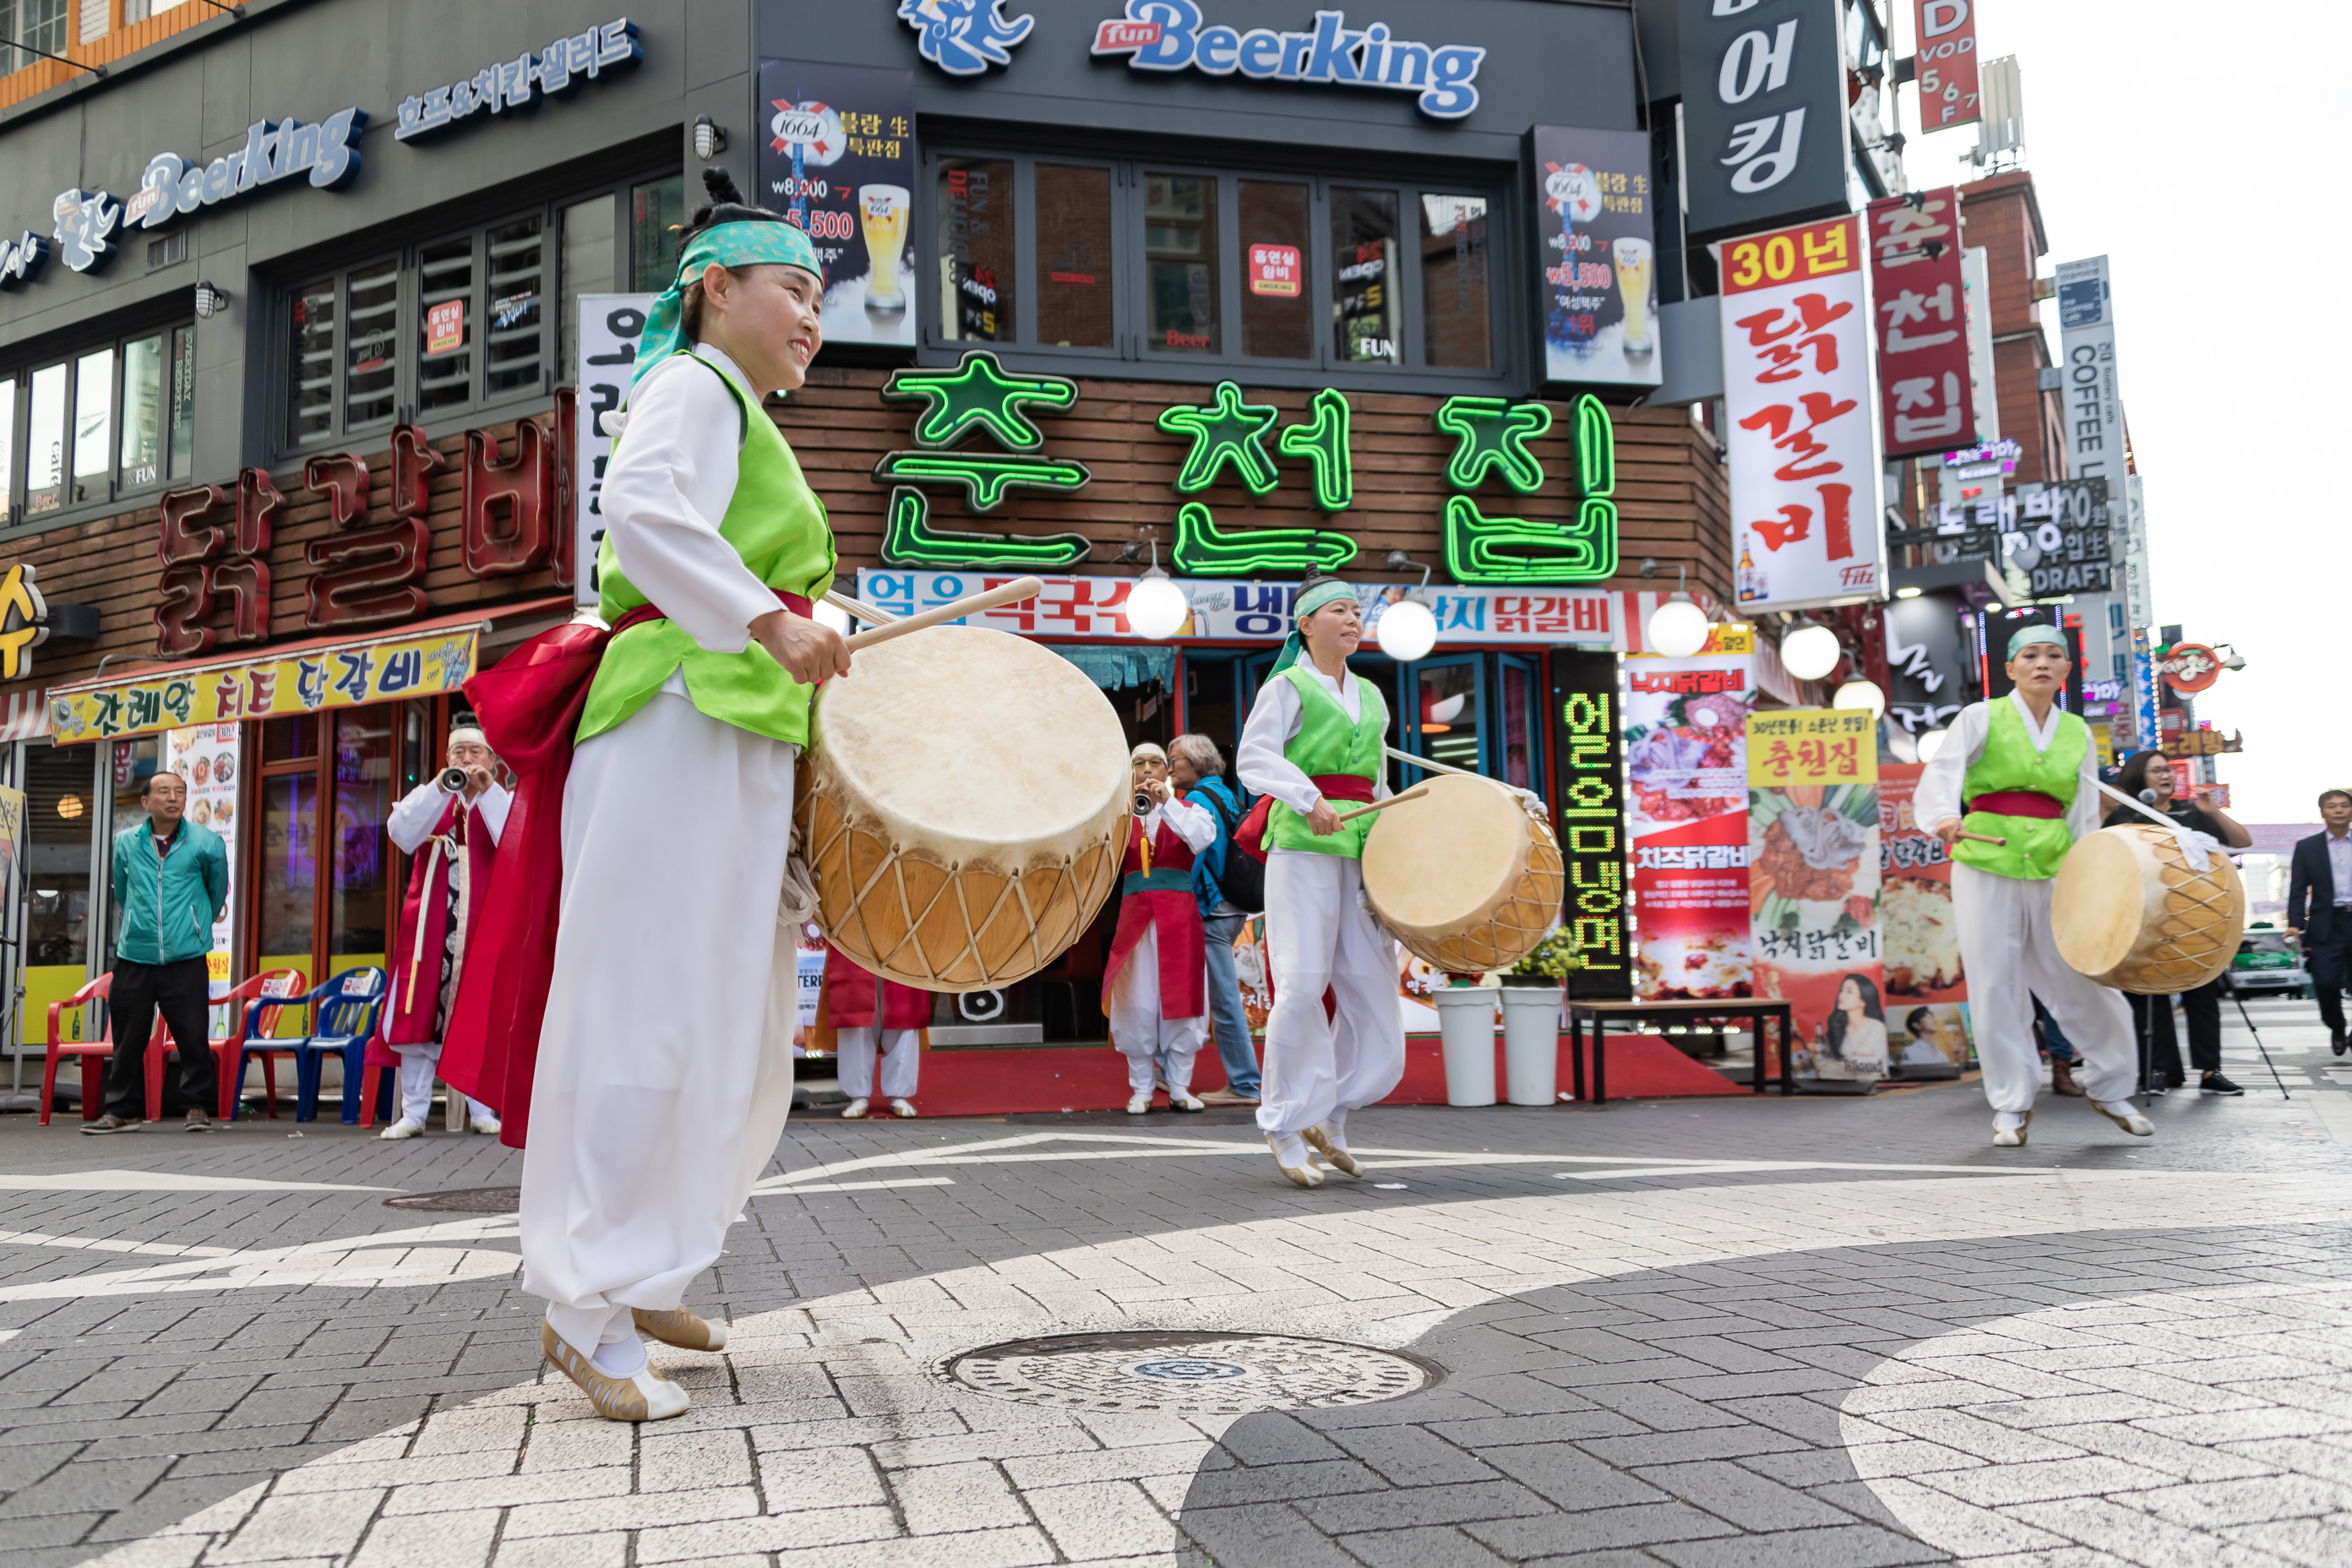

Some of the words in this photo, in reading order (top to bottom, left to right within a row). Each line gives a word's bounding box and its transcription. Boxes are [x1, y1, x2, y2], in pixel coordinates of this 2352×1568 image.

[1105, 23, 1153, 43] fun
[1127, 0, 1487, 118] Beerking
[1919, 35, 1976, 63] VOD
[779, 117, 819, 139] 1664
[890, 116, 910, 139] 生
[1941, 105, 1955, 123] F
[140, 107, 358, 228] Beerking
[1732, 223, 1850, 287] 30년
[1568, 313, 1594, 335] 1위
[1874, 199, 1963, 444] 춘천집
[1166, 329, 1210, 348] Beer
[1360, 338, 1396, 357] FUN
[2072, 344, 2104, 455] COFFEE
[1734, 292, 1858, 563] 닭갈비
[135, 467, 156, 485] FUN
[873, 350, 1619, 583] 춘천집
[1961, 486, 1983, 499] 3F
[154, 388, 577, 658] 닭갈비
[1937, 485, 2063, 553] 노래방
[1838, 561, 1875, 587] Fitz
[2033, 563, 2111, 592] DRAFT
[1233, 585, 1297, 635] 냉
[1493, 595, 1611, 634] 닭갈비
[296, 648, 422, 710] 닭갈비
[1631, 669, 1745, 694] 낙지닭갈비
[1762, 737, 1859, 777] 춘천집
[1636, 845, 1750, 870] 치즈닭갈비
[1759, 929, 1876, 961] 낙지닭갈비
